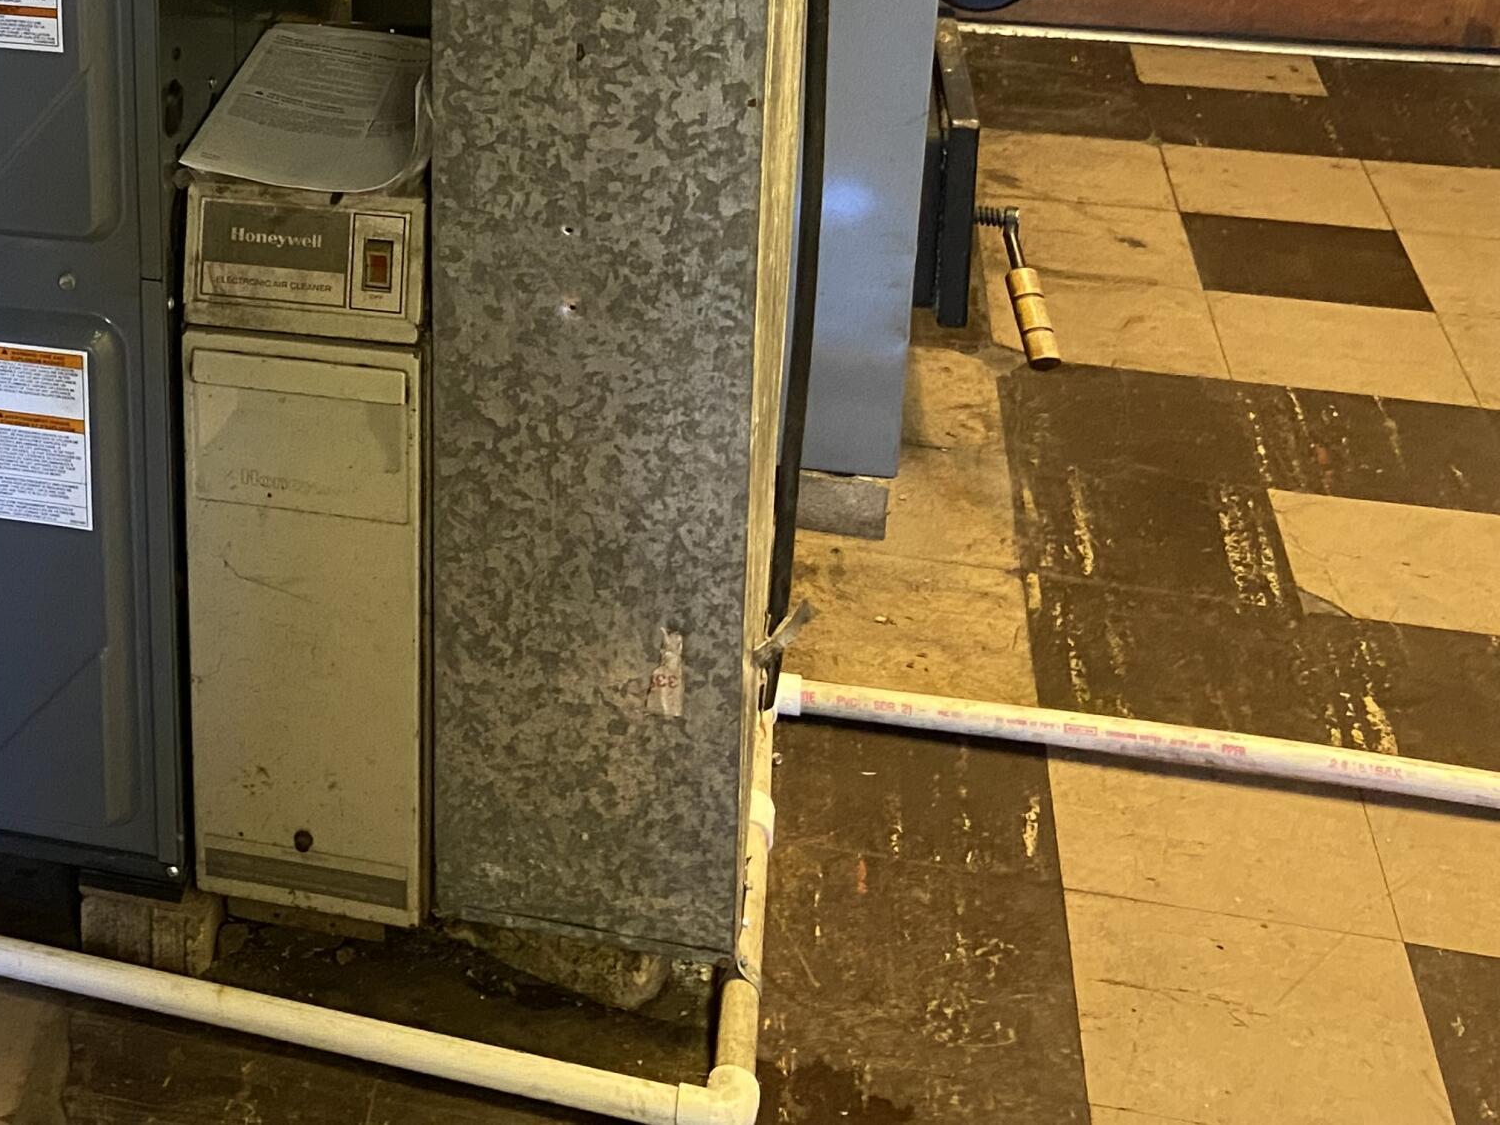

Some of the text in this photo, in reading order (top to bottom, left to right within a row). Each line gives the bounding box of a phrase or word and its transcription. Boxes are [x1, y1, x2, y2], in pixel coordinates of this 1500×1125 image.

[231, 226, 322, 249] Honeywell
[273, 281, 288, 289] AIR
[289, 281, 332, 293] CLEANER
[836, 695, 857, 709] PVC
